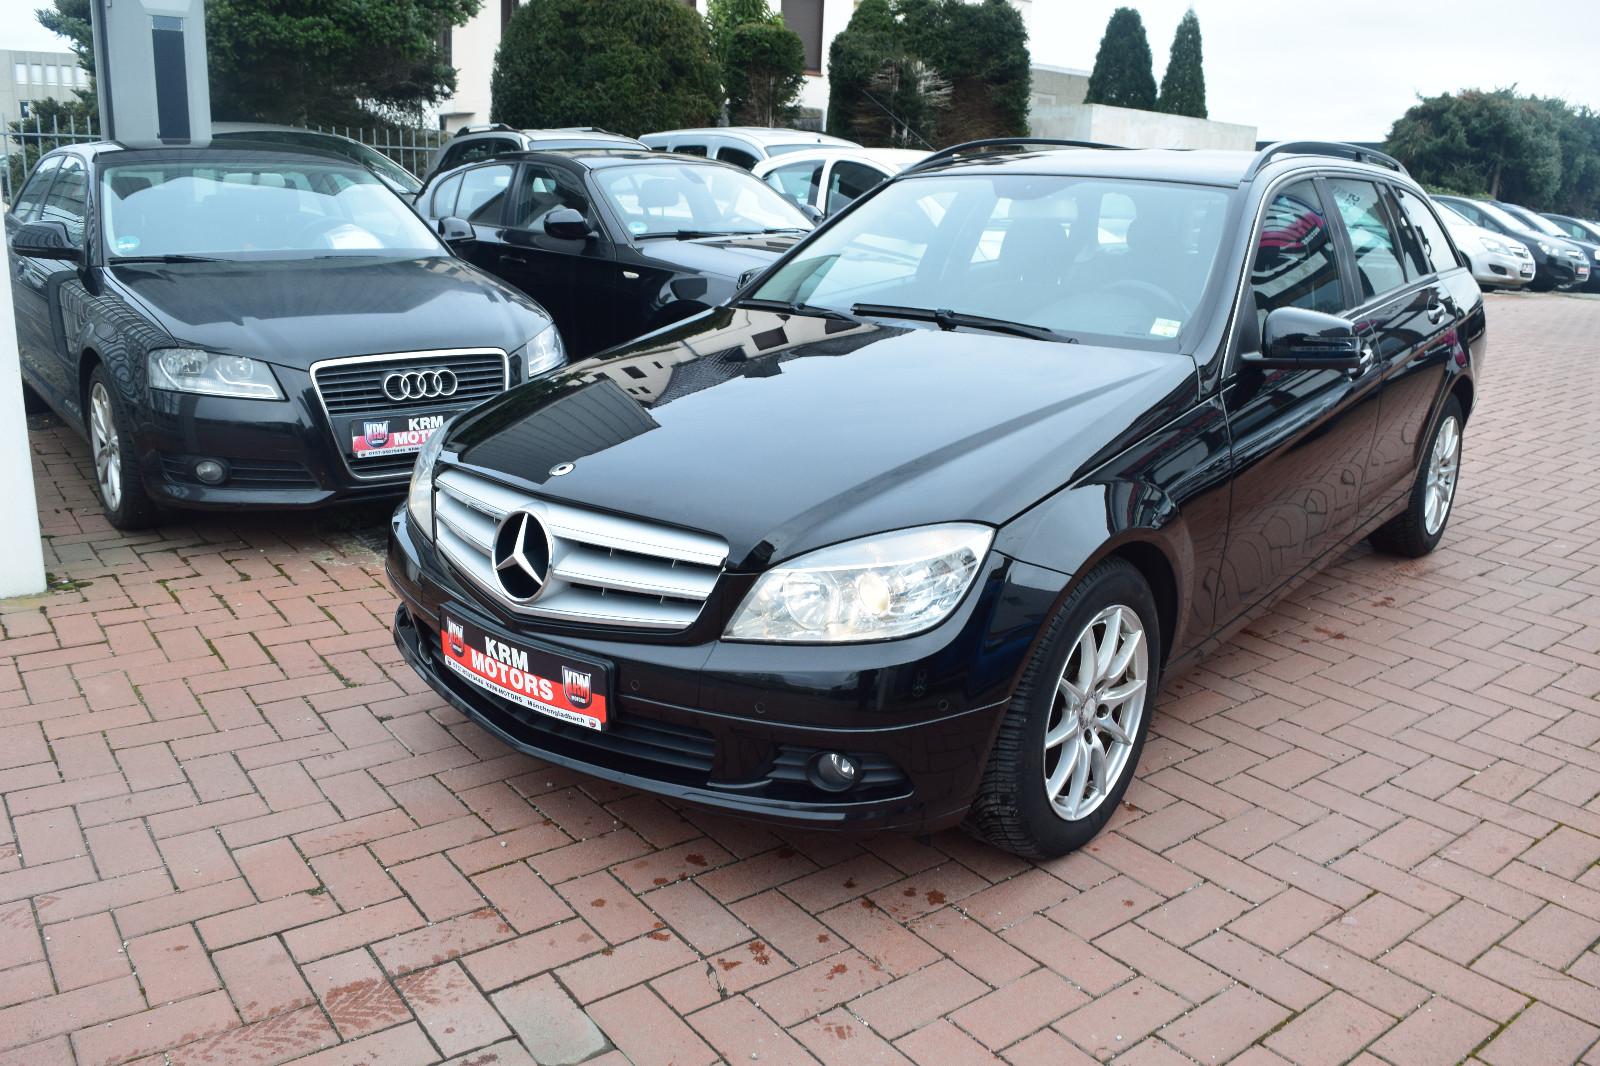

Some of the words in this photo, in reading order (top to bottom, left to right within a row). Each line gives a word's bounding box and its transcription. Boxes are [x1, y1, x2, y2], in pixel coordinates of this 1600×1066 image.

[393, 429, 437, 445] MOT
[408, 415, 444, 430] KRM
[484, 636, 529, 672] KRM
[471, 648, 554, 701] MOTORS
[564, 669, 590, 703] KRM
